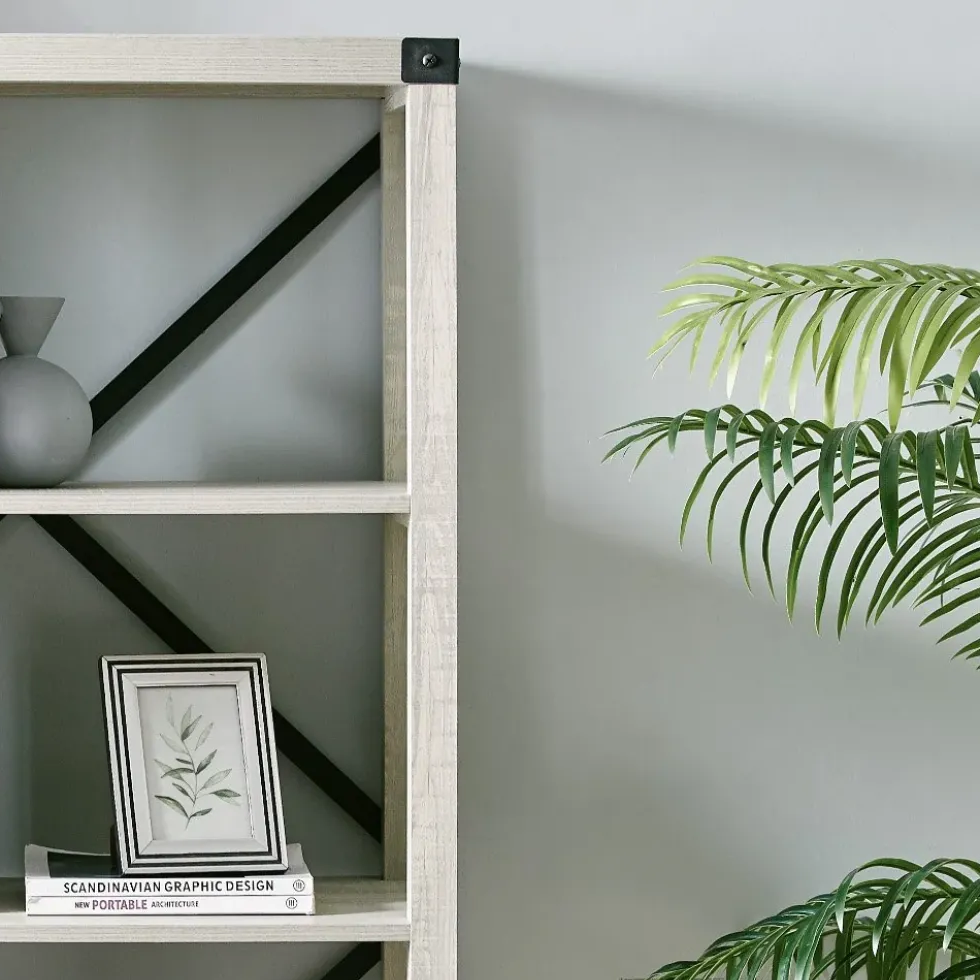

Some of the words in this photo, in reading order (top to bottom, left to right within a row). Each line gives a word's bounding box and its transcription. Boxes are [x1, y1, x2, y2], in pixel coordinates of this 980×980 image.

[63, 881, 160, 894] SCANDINAVIAN
[164, 881, 222, 892] GRAPHIC
[226, 879, 274, 891] DESIGN
[74, 901, 90, 909] NEW
[92, 899, 148, 910] PORTABLE
[151, 900, 199, 908] ARCHITECTURE
